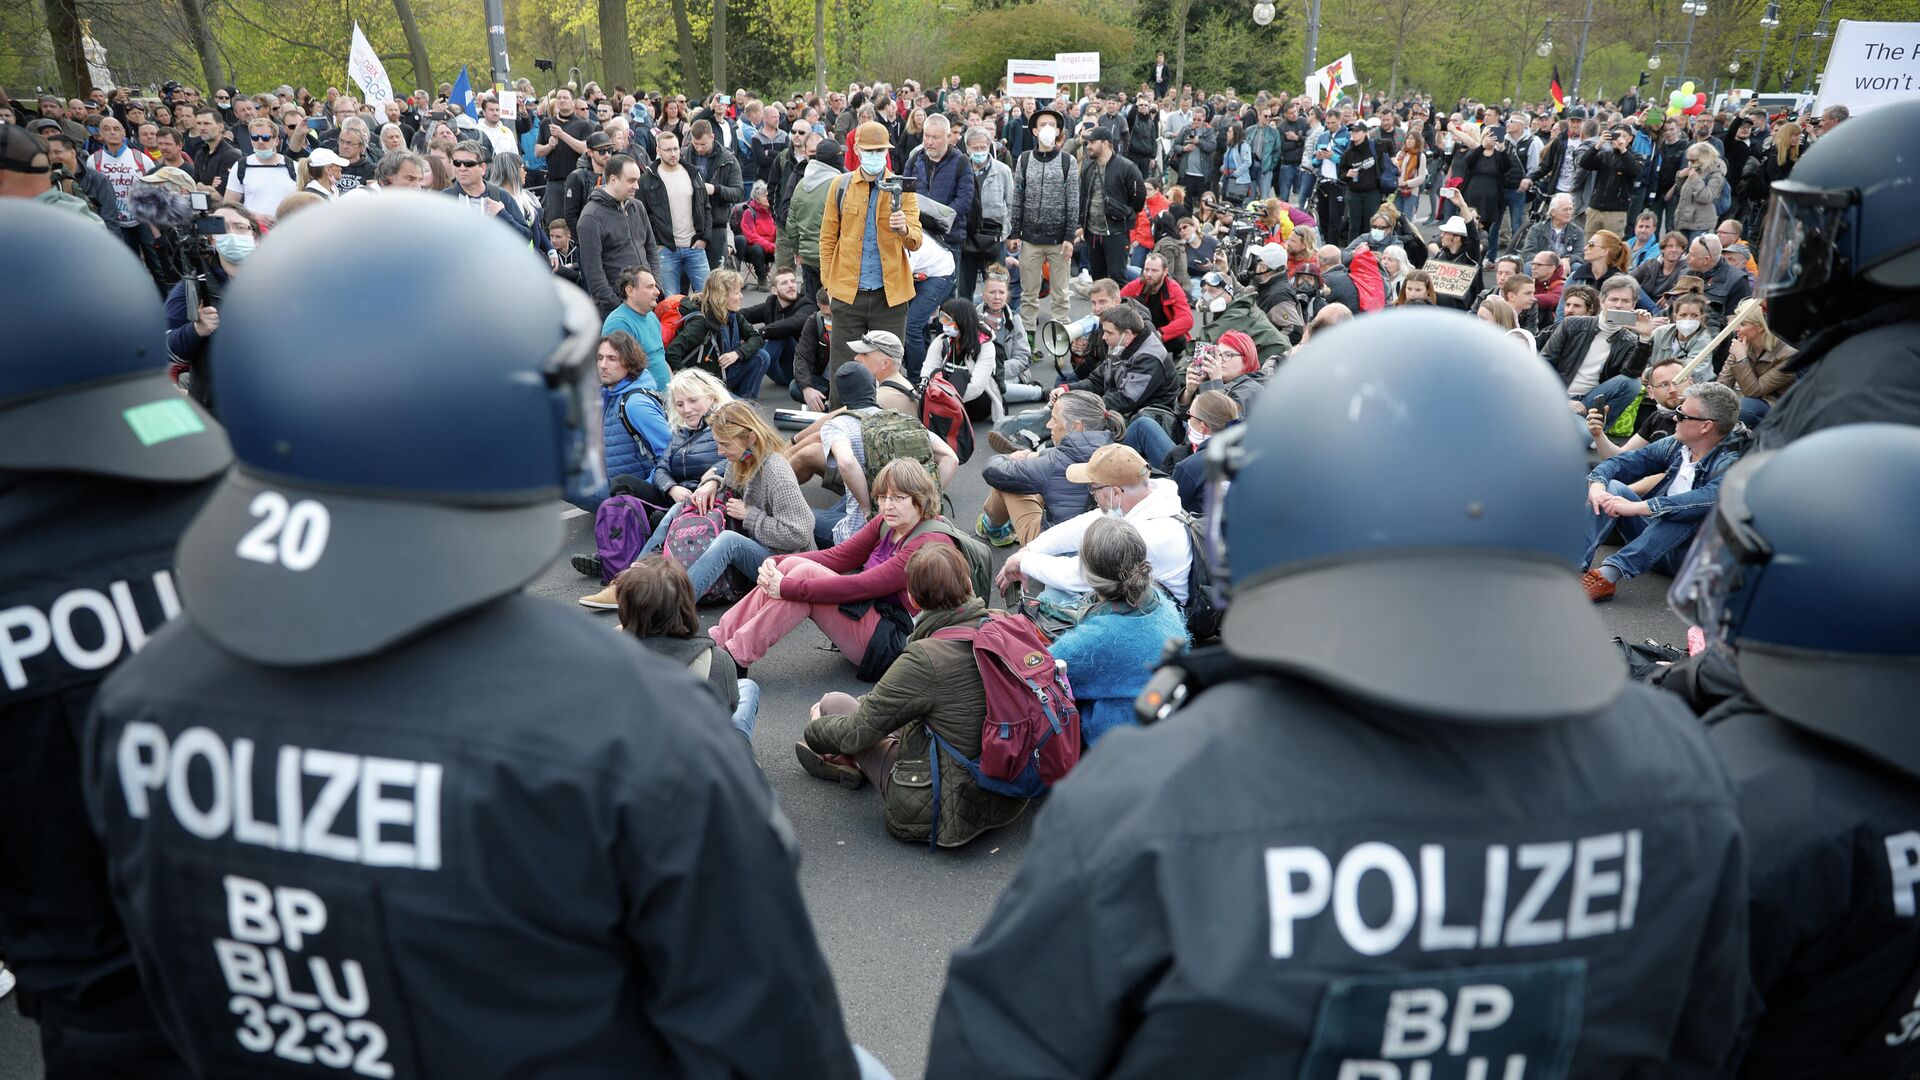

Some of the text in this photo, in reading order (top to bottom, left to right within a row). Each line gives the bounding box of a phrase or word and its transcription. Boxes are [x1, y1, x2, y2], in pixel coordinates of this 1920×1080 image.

[1057, 71, 1087, 80] Verstand
[1061, 55, 1081, 64] Angst
[1865, 42, 1904, 60] The
[103, 163, 132, 174] Söder
[107, 175, 134, 186] erkel
[1438, 265, 1460, 277] DARE
[236, 491, 331, 571] 20
[117, 720, 443, 871] POLIZEI
[223, 874, 327, 952] BP
[1264, 829, 1642, 959] POLIZEI
[213, 937, 370, 1018] BLU
[228, 995, 395, 1080] 3232
[1380, 984, 1514, 1058] BP
